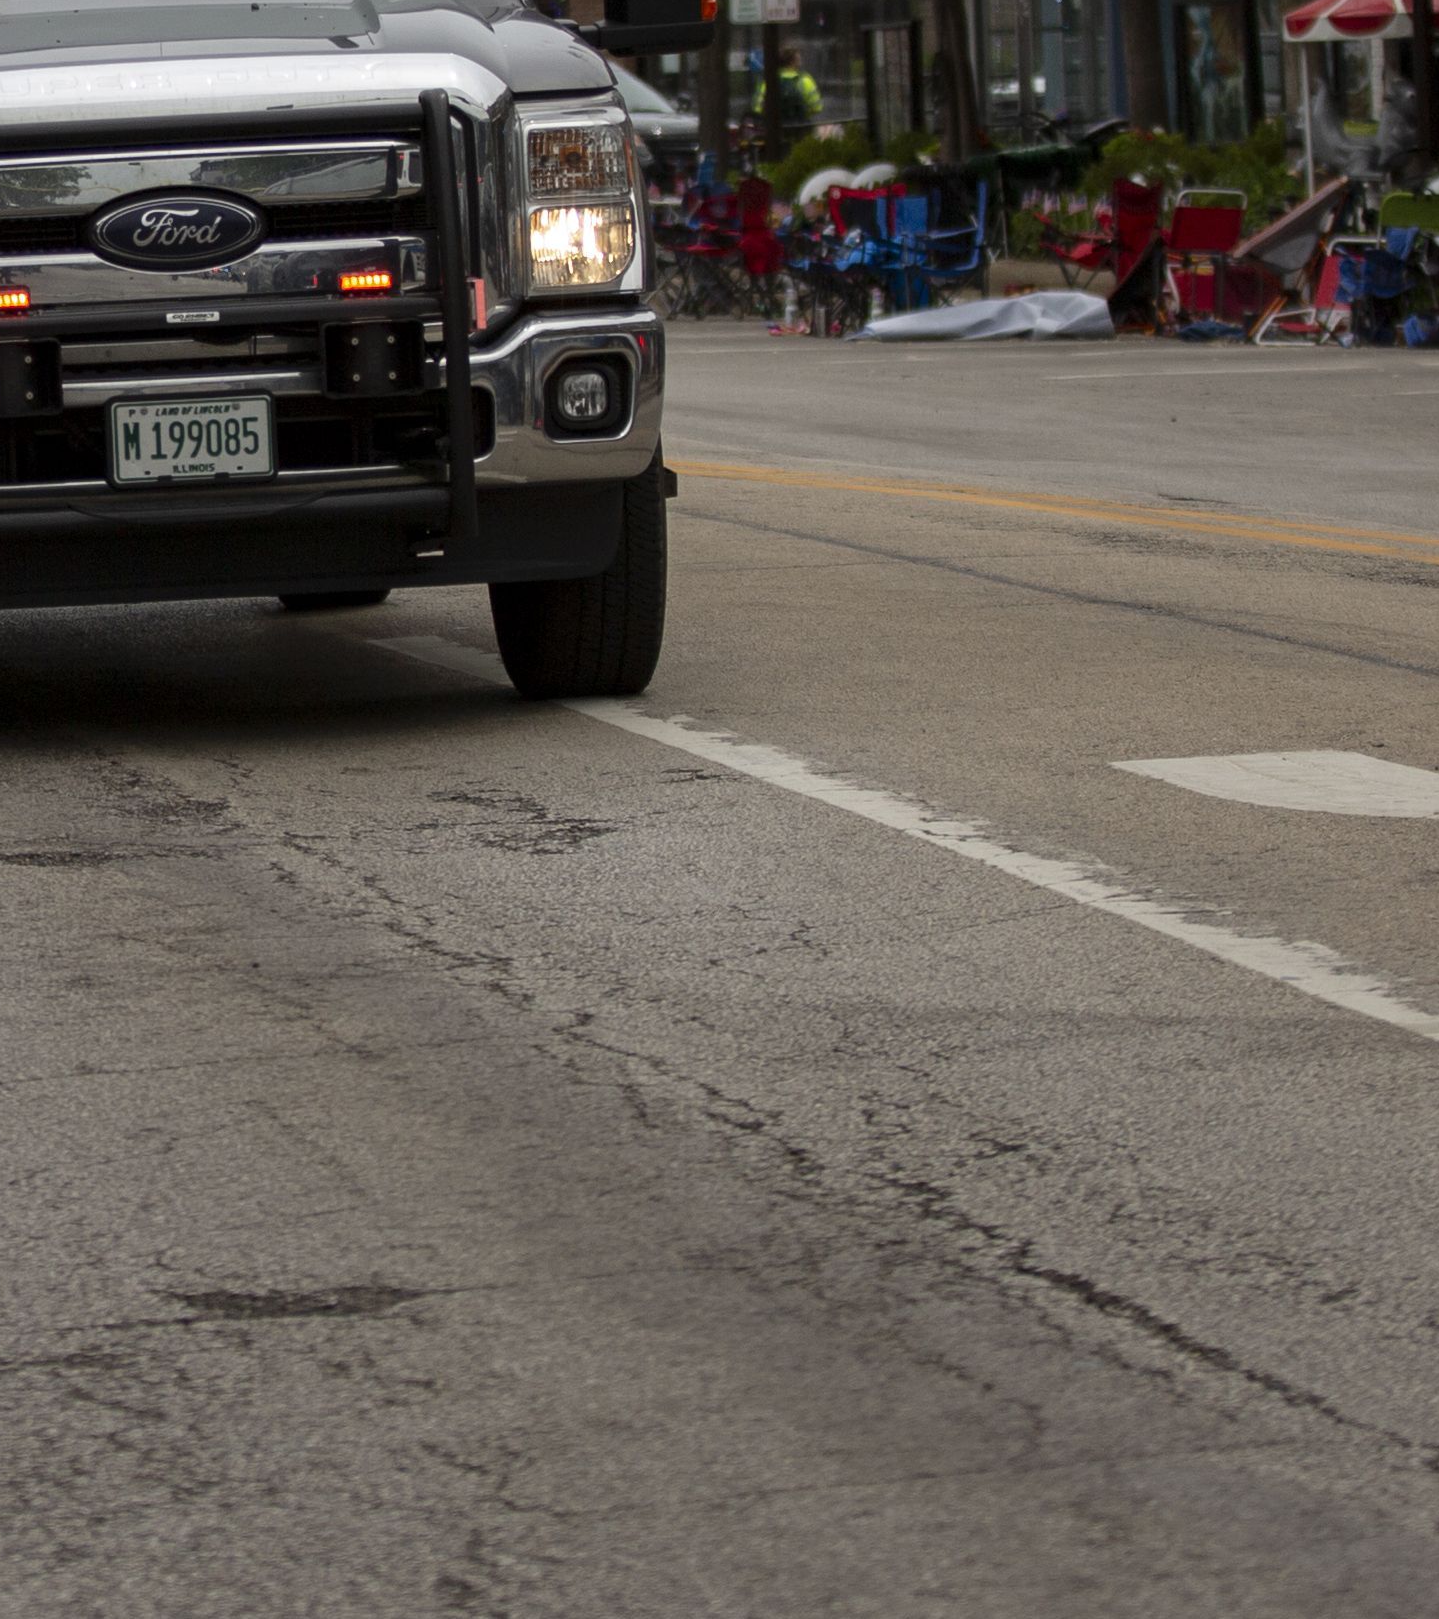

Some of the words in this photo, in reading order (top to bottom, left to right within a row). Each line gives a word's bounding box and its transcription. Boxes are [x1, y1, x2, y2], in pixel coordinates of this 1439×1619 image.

[132, 208, 223, 248] Ford
[155, 405, 179, 417] LAND
[181, 405, 193, 416] OF
[194, 404, 231, 415] LINCOLN
[123, 422, 141, 460] M
[151, 417, 260, 460] 199085
[172, 463, 216, 474] ILLINOIS
